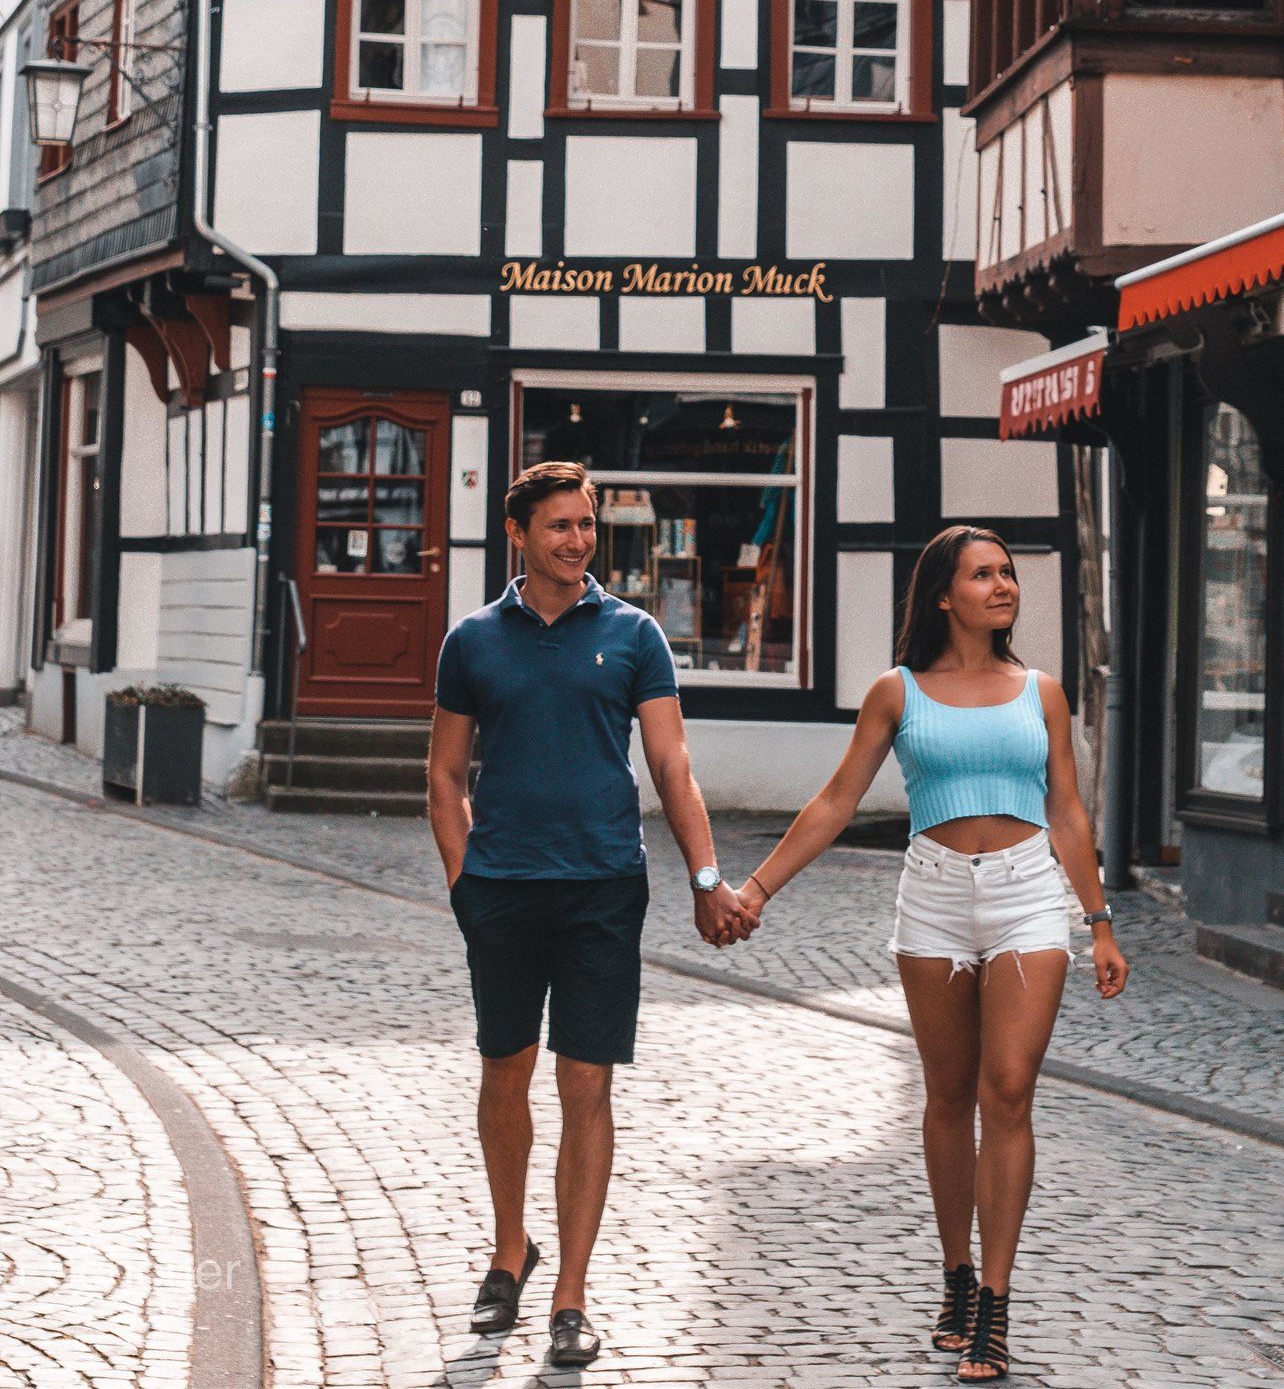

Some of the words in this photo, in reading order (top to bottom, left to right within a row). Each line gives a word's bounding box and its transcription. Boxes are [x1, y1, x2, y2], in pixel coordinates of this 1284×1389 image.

[500, 261, 613, 292] Maison
[621, 262, 734, 294] Marion
[741, 262, 833, 303] Muck
